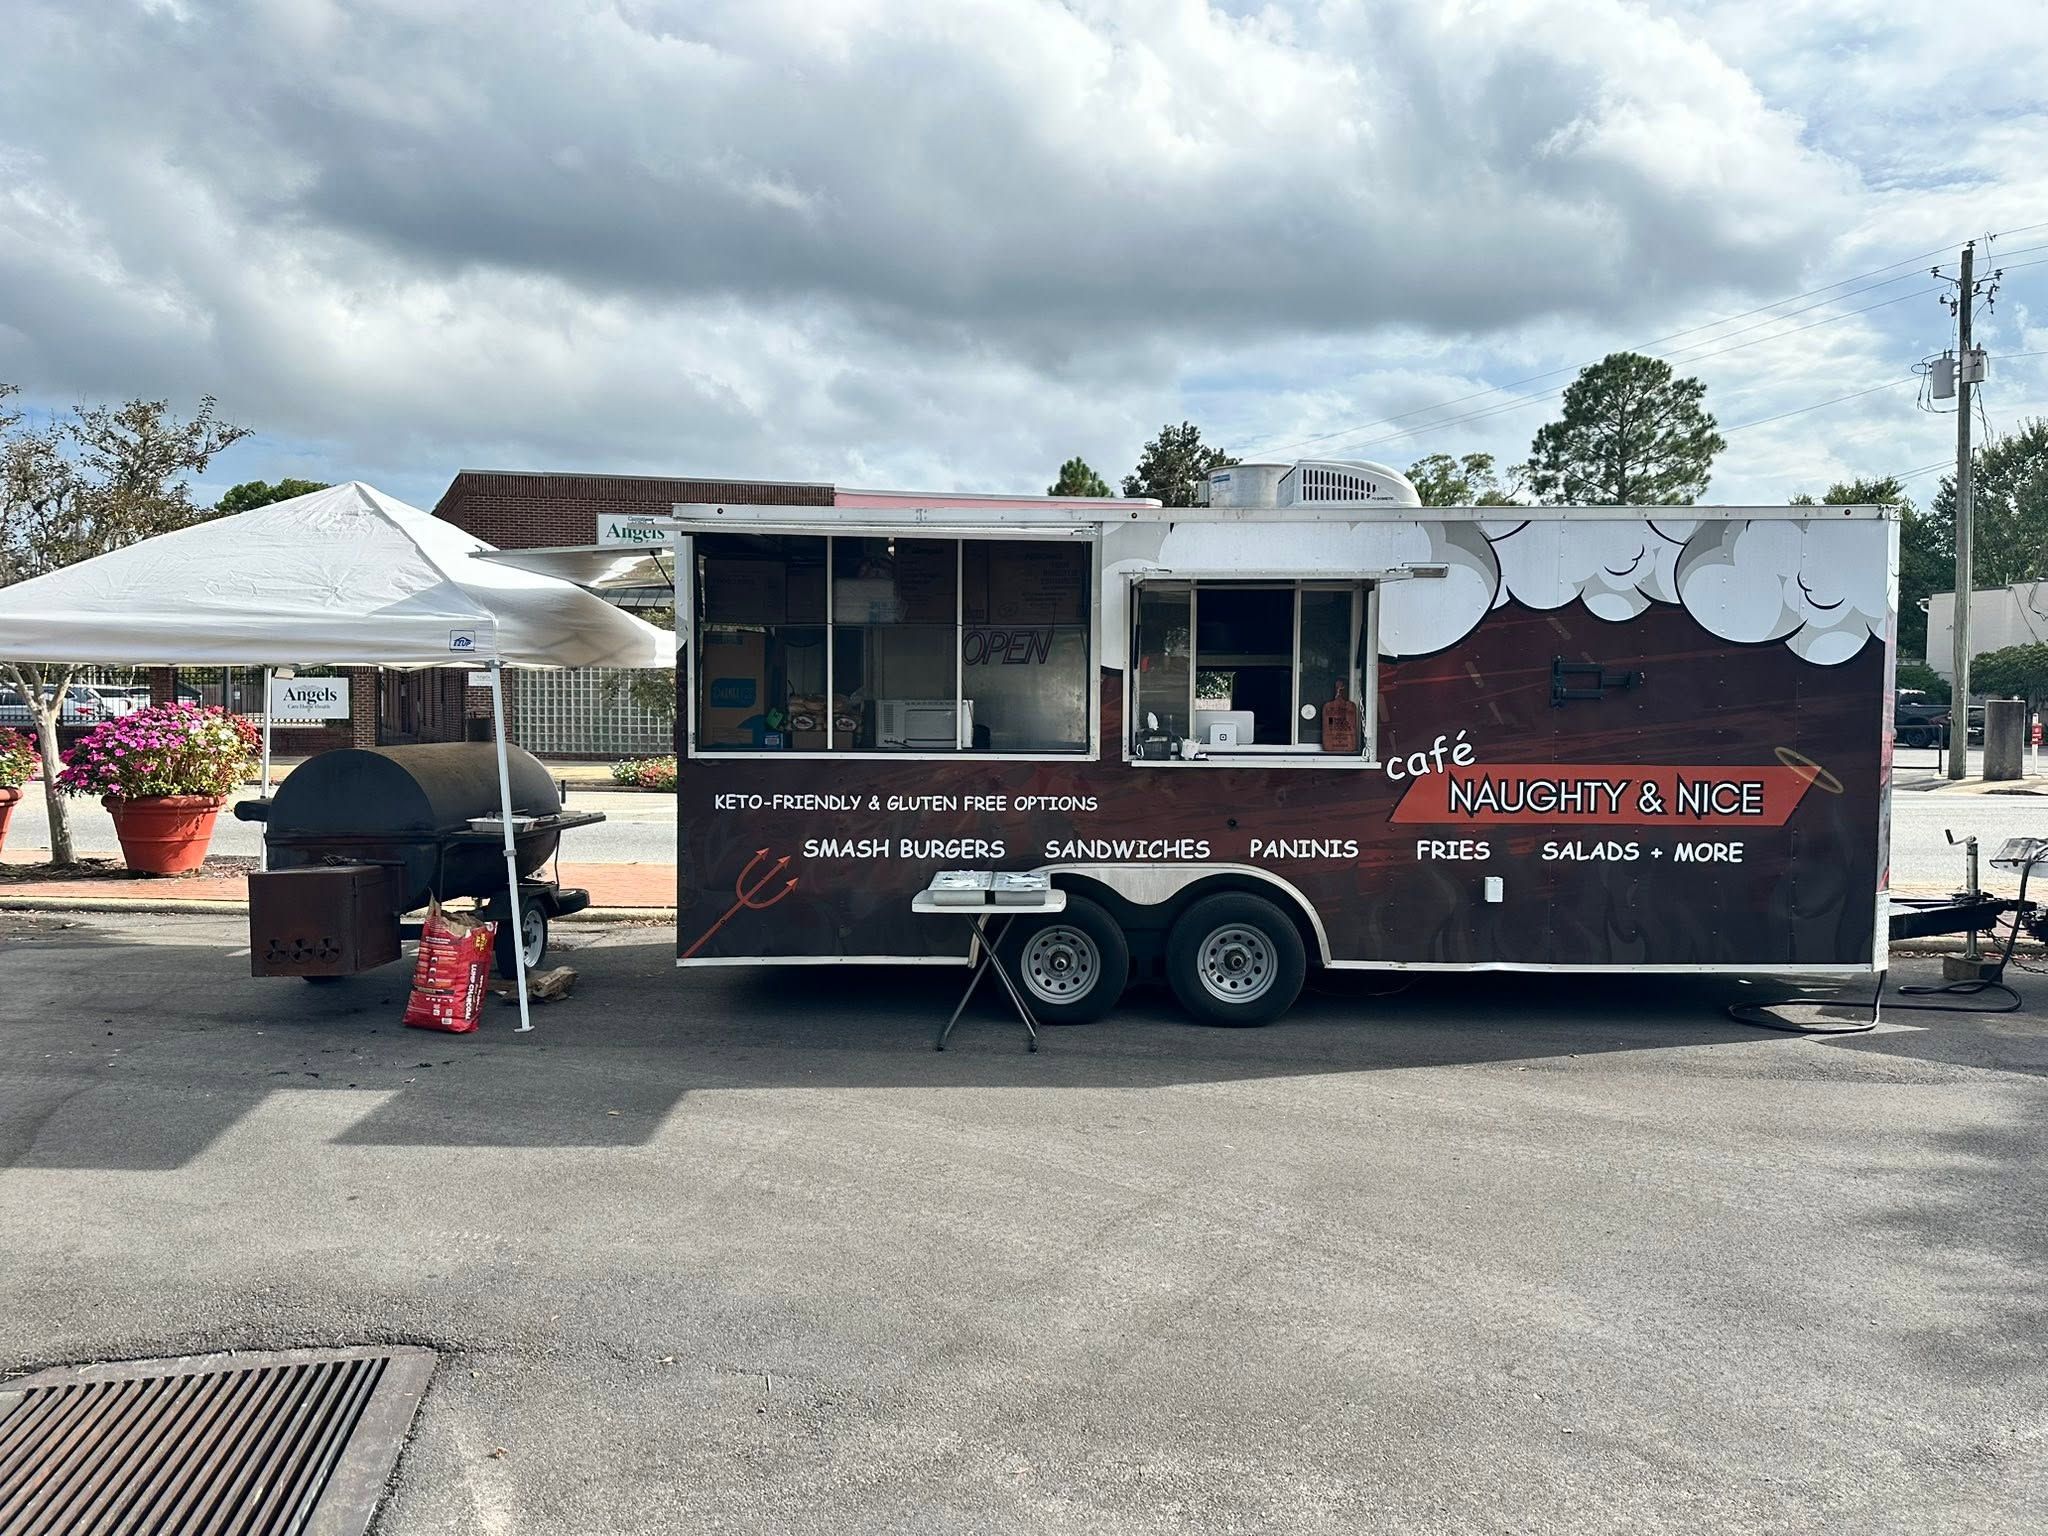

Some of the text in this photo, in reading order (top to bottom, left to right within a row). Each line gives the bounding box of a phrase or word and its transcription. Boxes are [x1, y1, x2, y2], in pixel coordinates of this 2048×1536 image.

[962, 631, 1055, 666] OPEN
[283, 687, 338, 705] Angels
[1385, 729, 1477, 781] café
[715, 793, 1098, 812] KETO-FRIENDLY & GLUTEN FREE OPTIONS
[1450, 777, 1763, 816] NAUGHTY & NICE
[803, 838, 1006, 859] SMASH BURGERS
[1044, 838, 1213, 860] SANDWICHES
[1250, 838, 1360, 860] PANINIS
[1416, 839, 1491, 861] FRIES
[1541, 840, 1745, 863] SALADS + MORE
